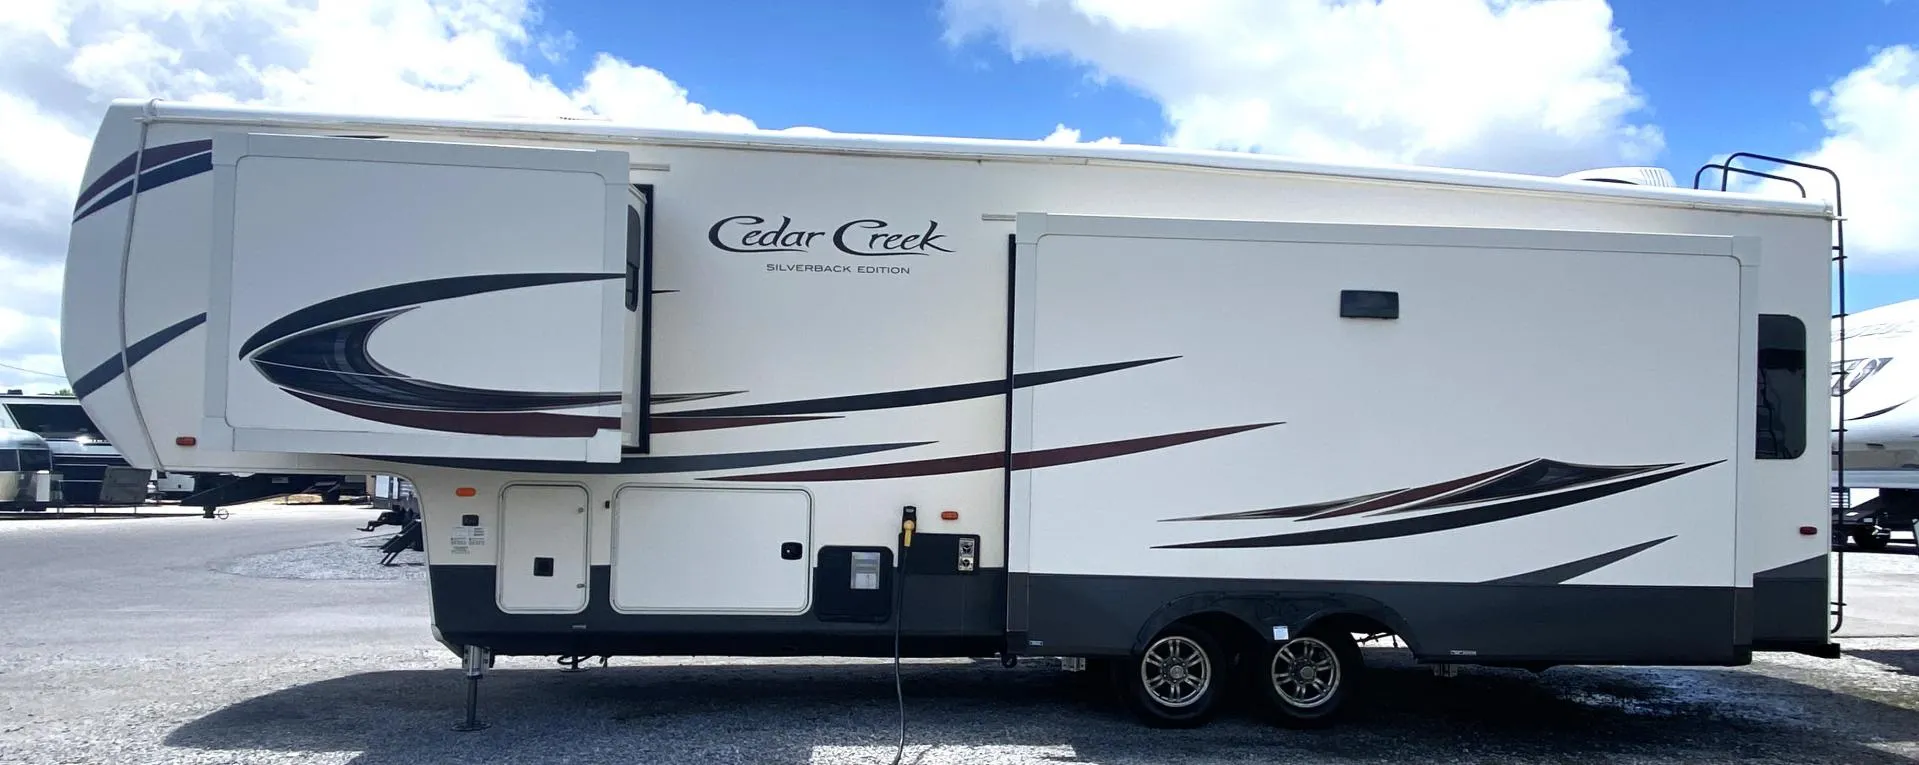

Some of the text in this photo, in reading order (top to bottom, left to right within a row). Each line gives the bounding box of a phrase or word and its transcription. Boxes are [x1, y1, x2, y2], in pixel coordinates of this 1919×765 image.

[708, 215, 958, 256] Cedar Creek
[766, 263, 910, 275] SILVERBACK EDITION
